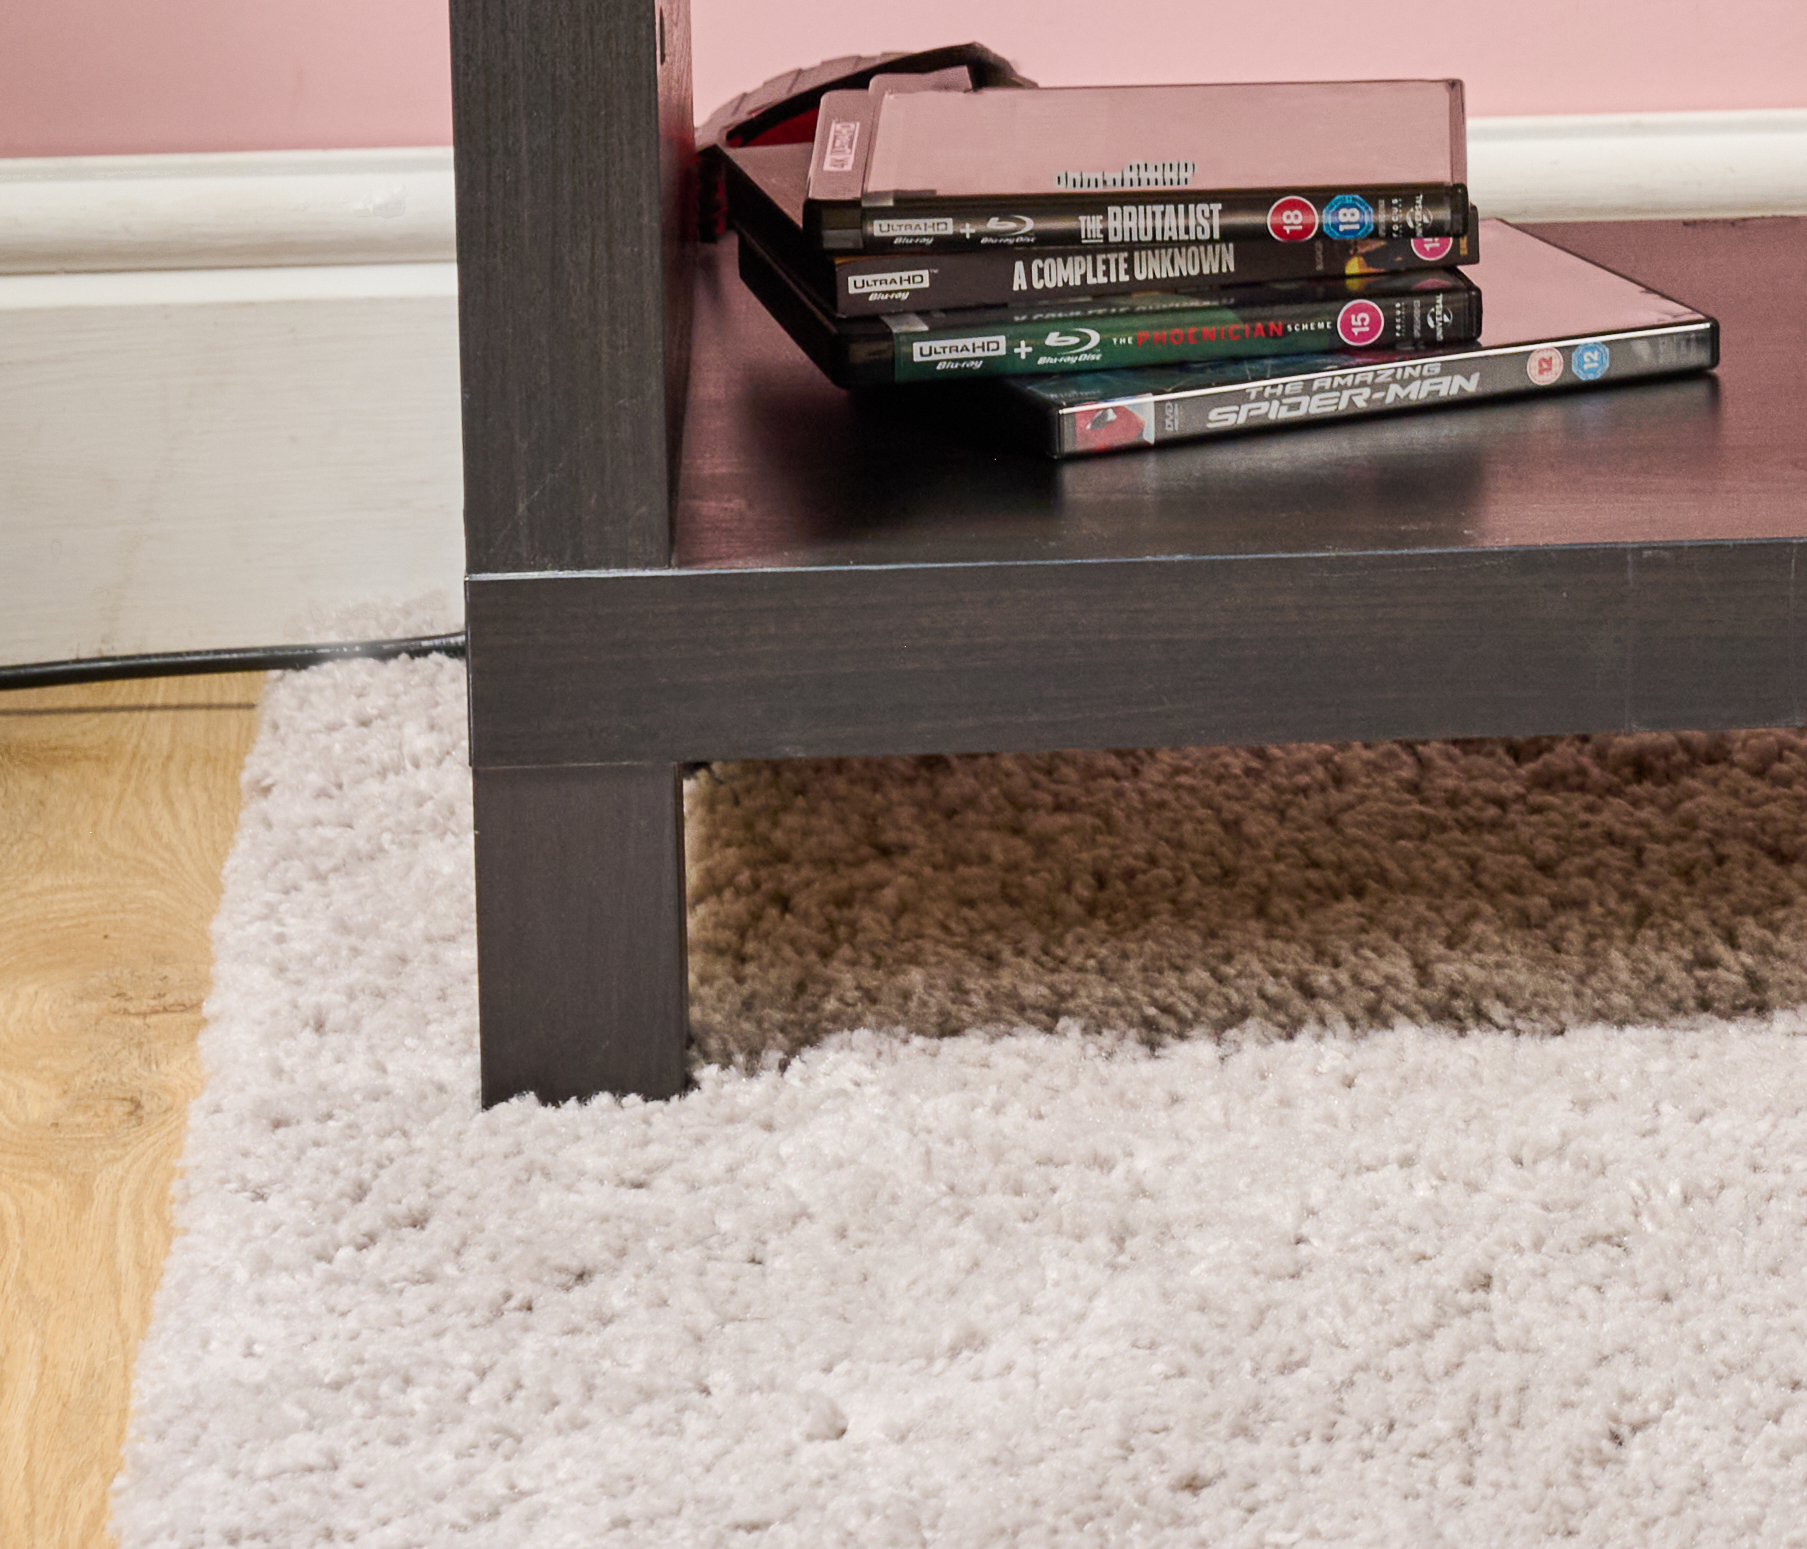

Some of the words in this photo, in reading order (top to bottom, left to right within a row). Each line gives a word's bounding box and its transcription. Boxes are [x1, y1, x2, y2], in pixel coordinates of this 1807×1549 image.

[1079, 215, 1104, 239] THE
[1107, 203, 1222, 243] BRUTALIST
[1282, 209, 1303, 234] 18
[1338, 207, 1360, 231] 18
[1013, 261, 1027, 291] A
[1031, 252, 1130, 289] COMPLETE
[1133, 243, 1235, 280] UNKNOWN
[1112, 336, 1133, 345] THE
[1137, 321, 1283, 347] PHOENICIAN
[1287, 321, 1332, 332] SCHEME
[1351, 312, 1370, 336] 15
[936, 359, 983, 370] Blu-ray
[1583, 351, 1599, 370] 12
[1246, 379, 1308, 401] THE
[1312, 363, 1442, 393] AMAZING
[1206, 370, 1480, 430] SPIDER-MAN
